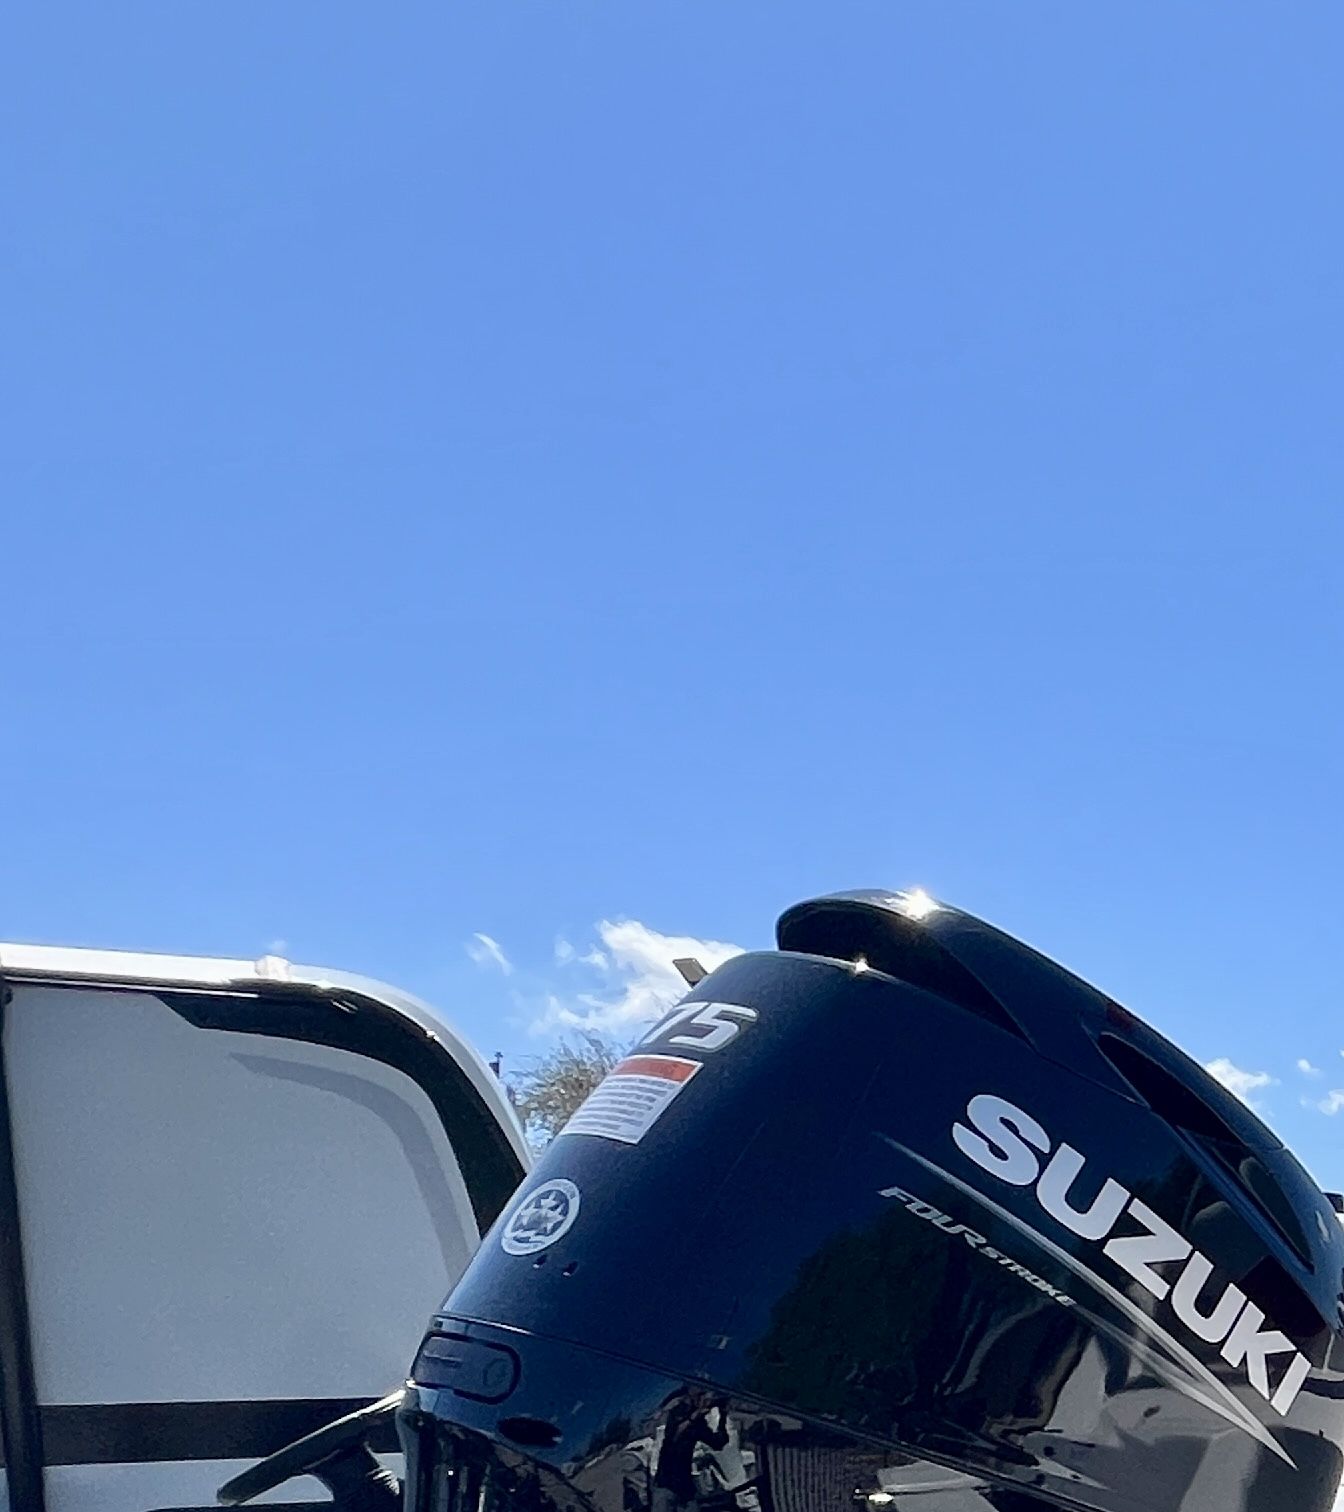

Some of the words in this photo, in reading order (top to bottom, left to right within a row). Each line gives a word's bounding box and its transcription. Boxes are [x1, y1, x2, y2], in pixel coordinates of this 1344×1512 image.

[877, 1186, 988, 1249] FOUR
[978, 1246, 1077, 1308] STROKE
[952, 1094, 1312, 1417] SUZUKI
